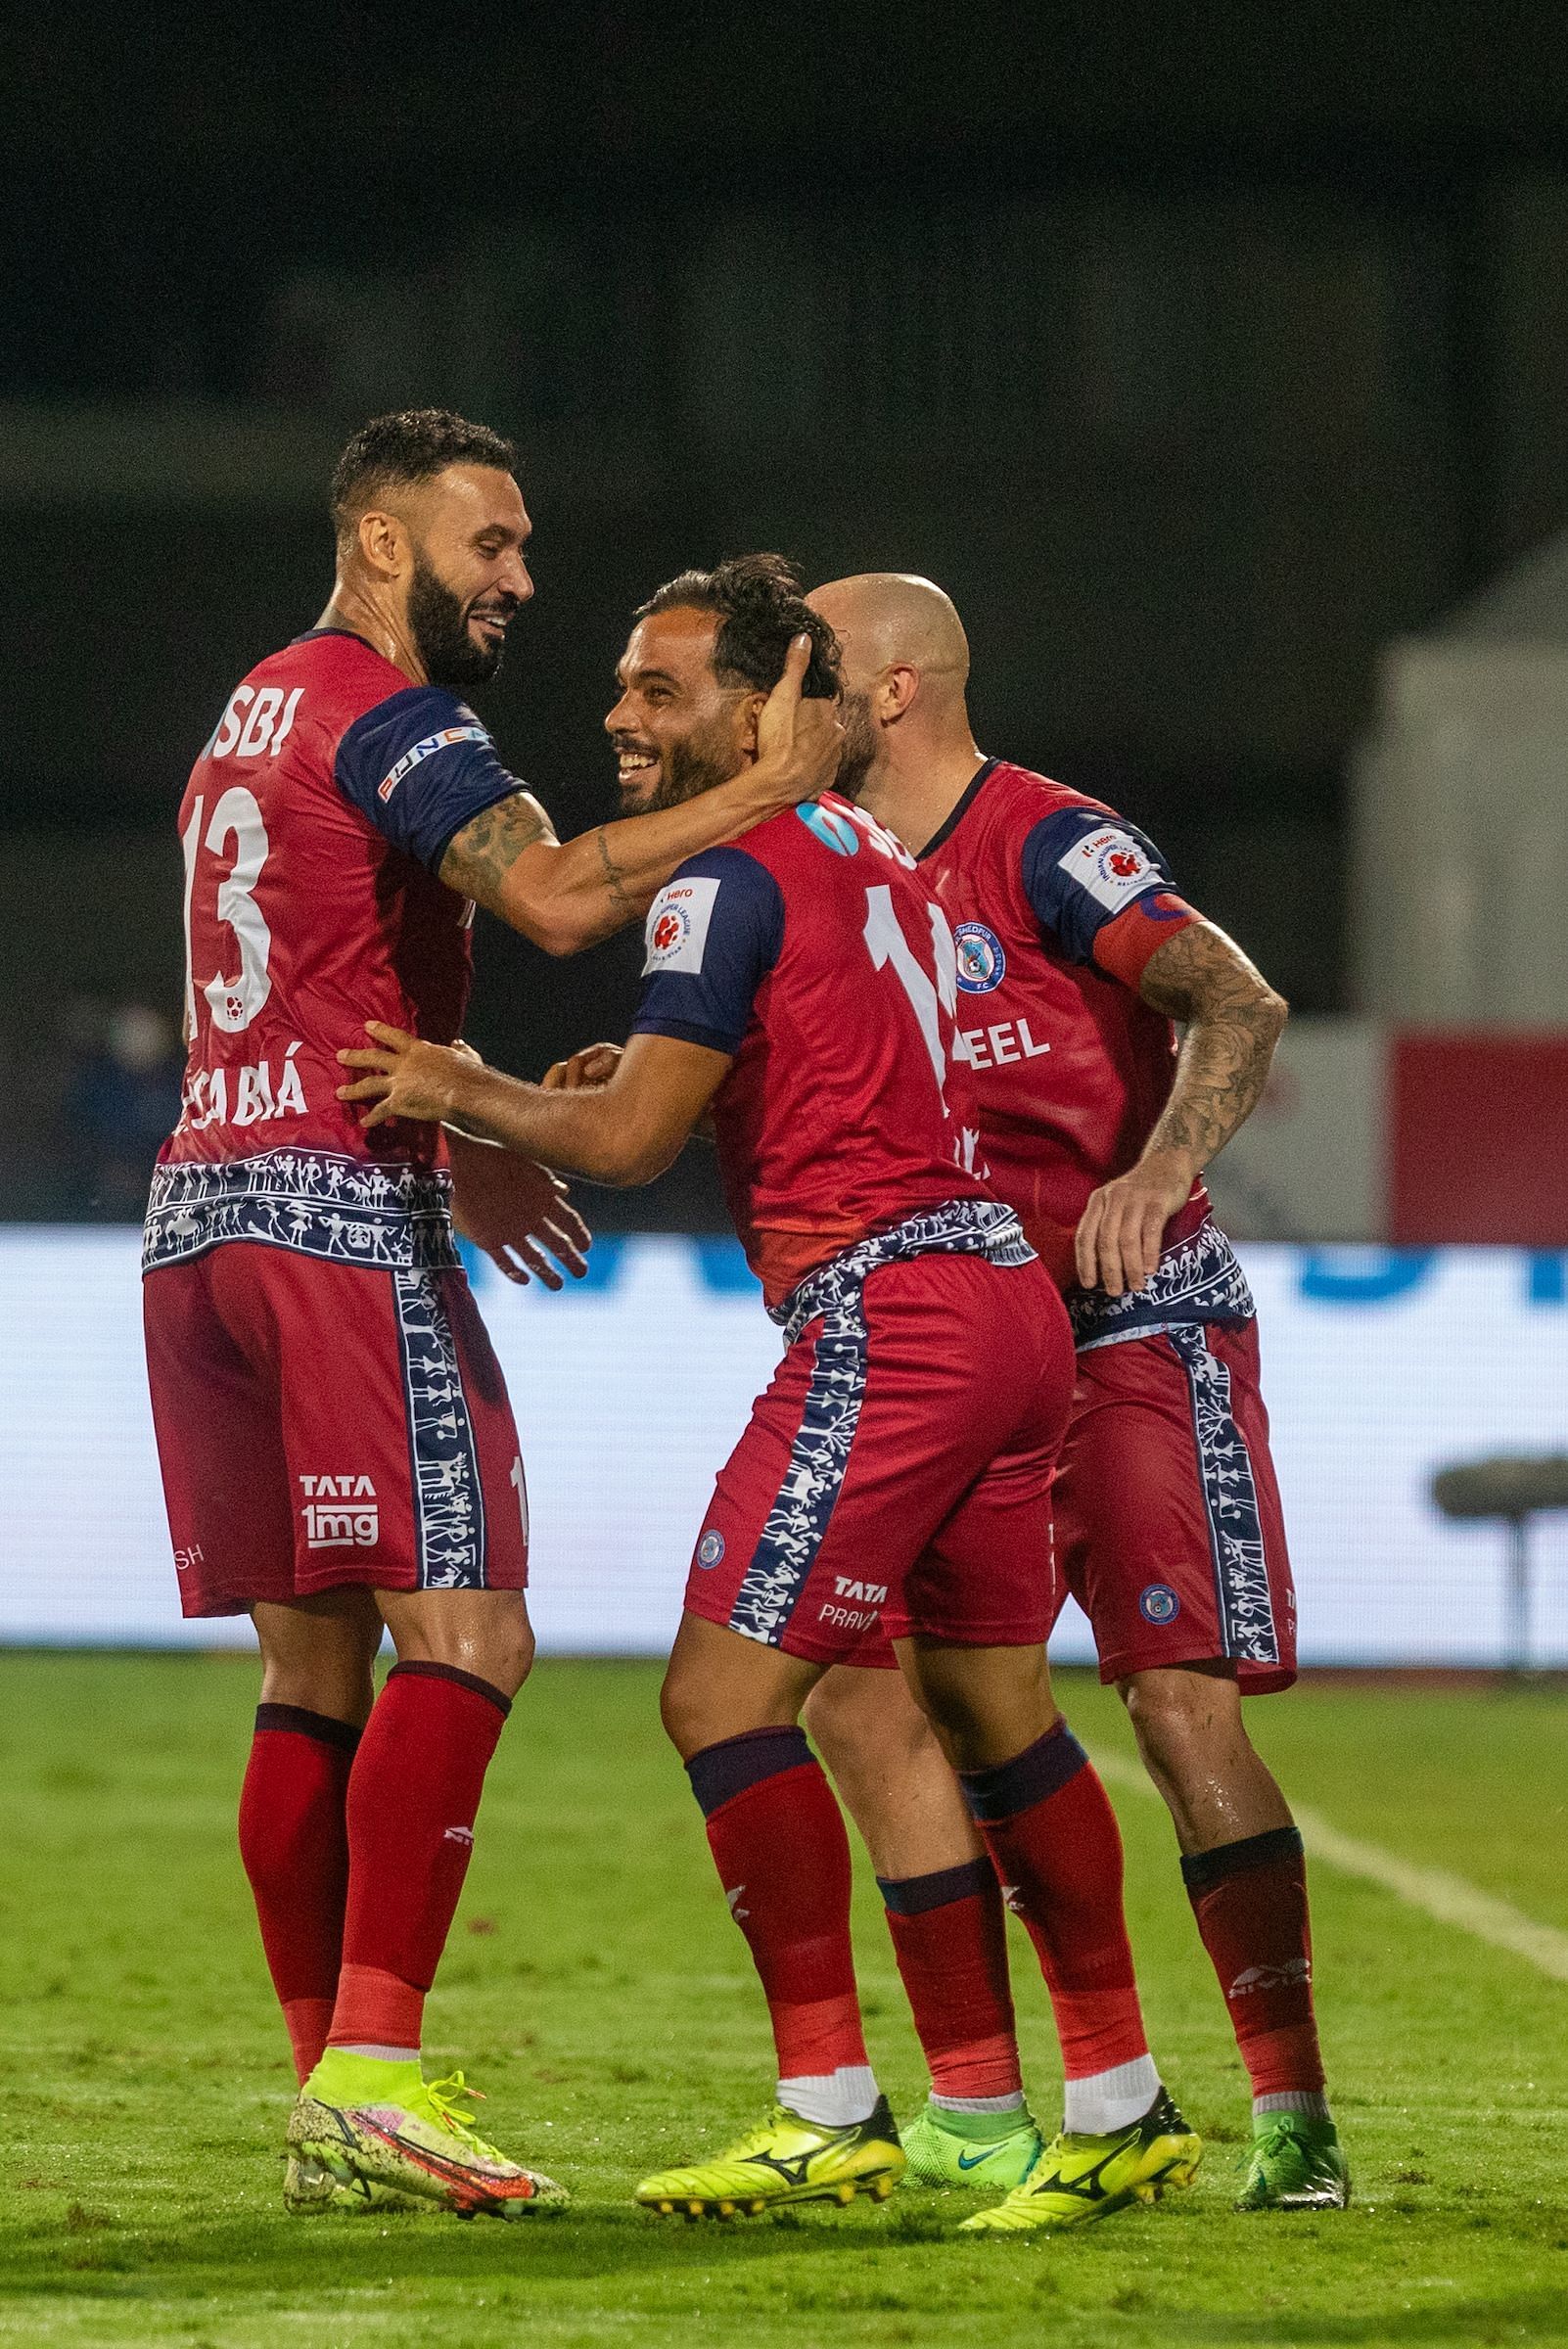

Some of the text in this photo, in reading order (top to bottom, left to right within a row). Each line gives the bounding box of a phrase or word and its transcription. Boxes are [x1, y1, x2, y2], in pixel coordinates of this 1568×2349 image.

[212, 685, 305, 758] SBI
[181, 787, 272, 1040] 13
[299, 1475, 376, 1497] TATA
[300, 1503, 380, 1548] 1mg
[835, 1575, 889, 1603] TATA
